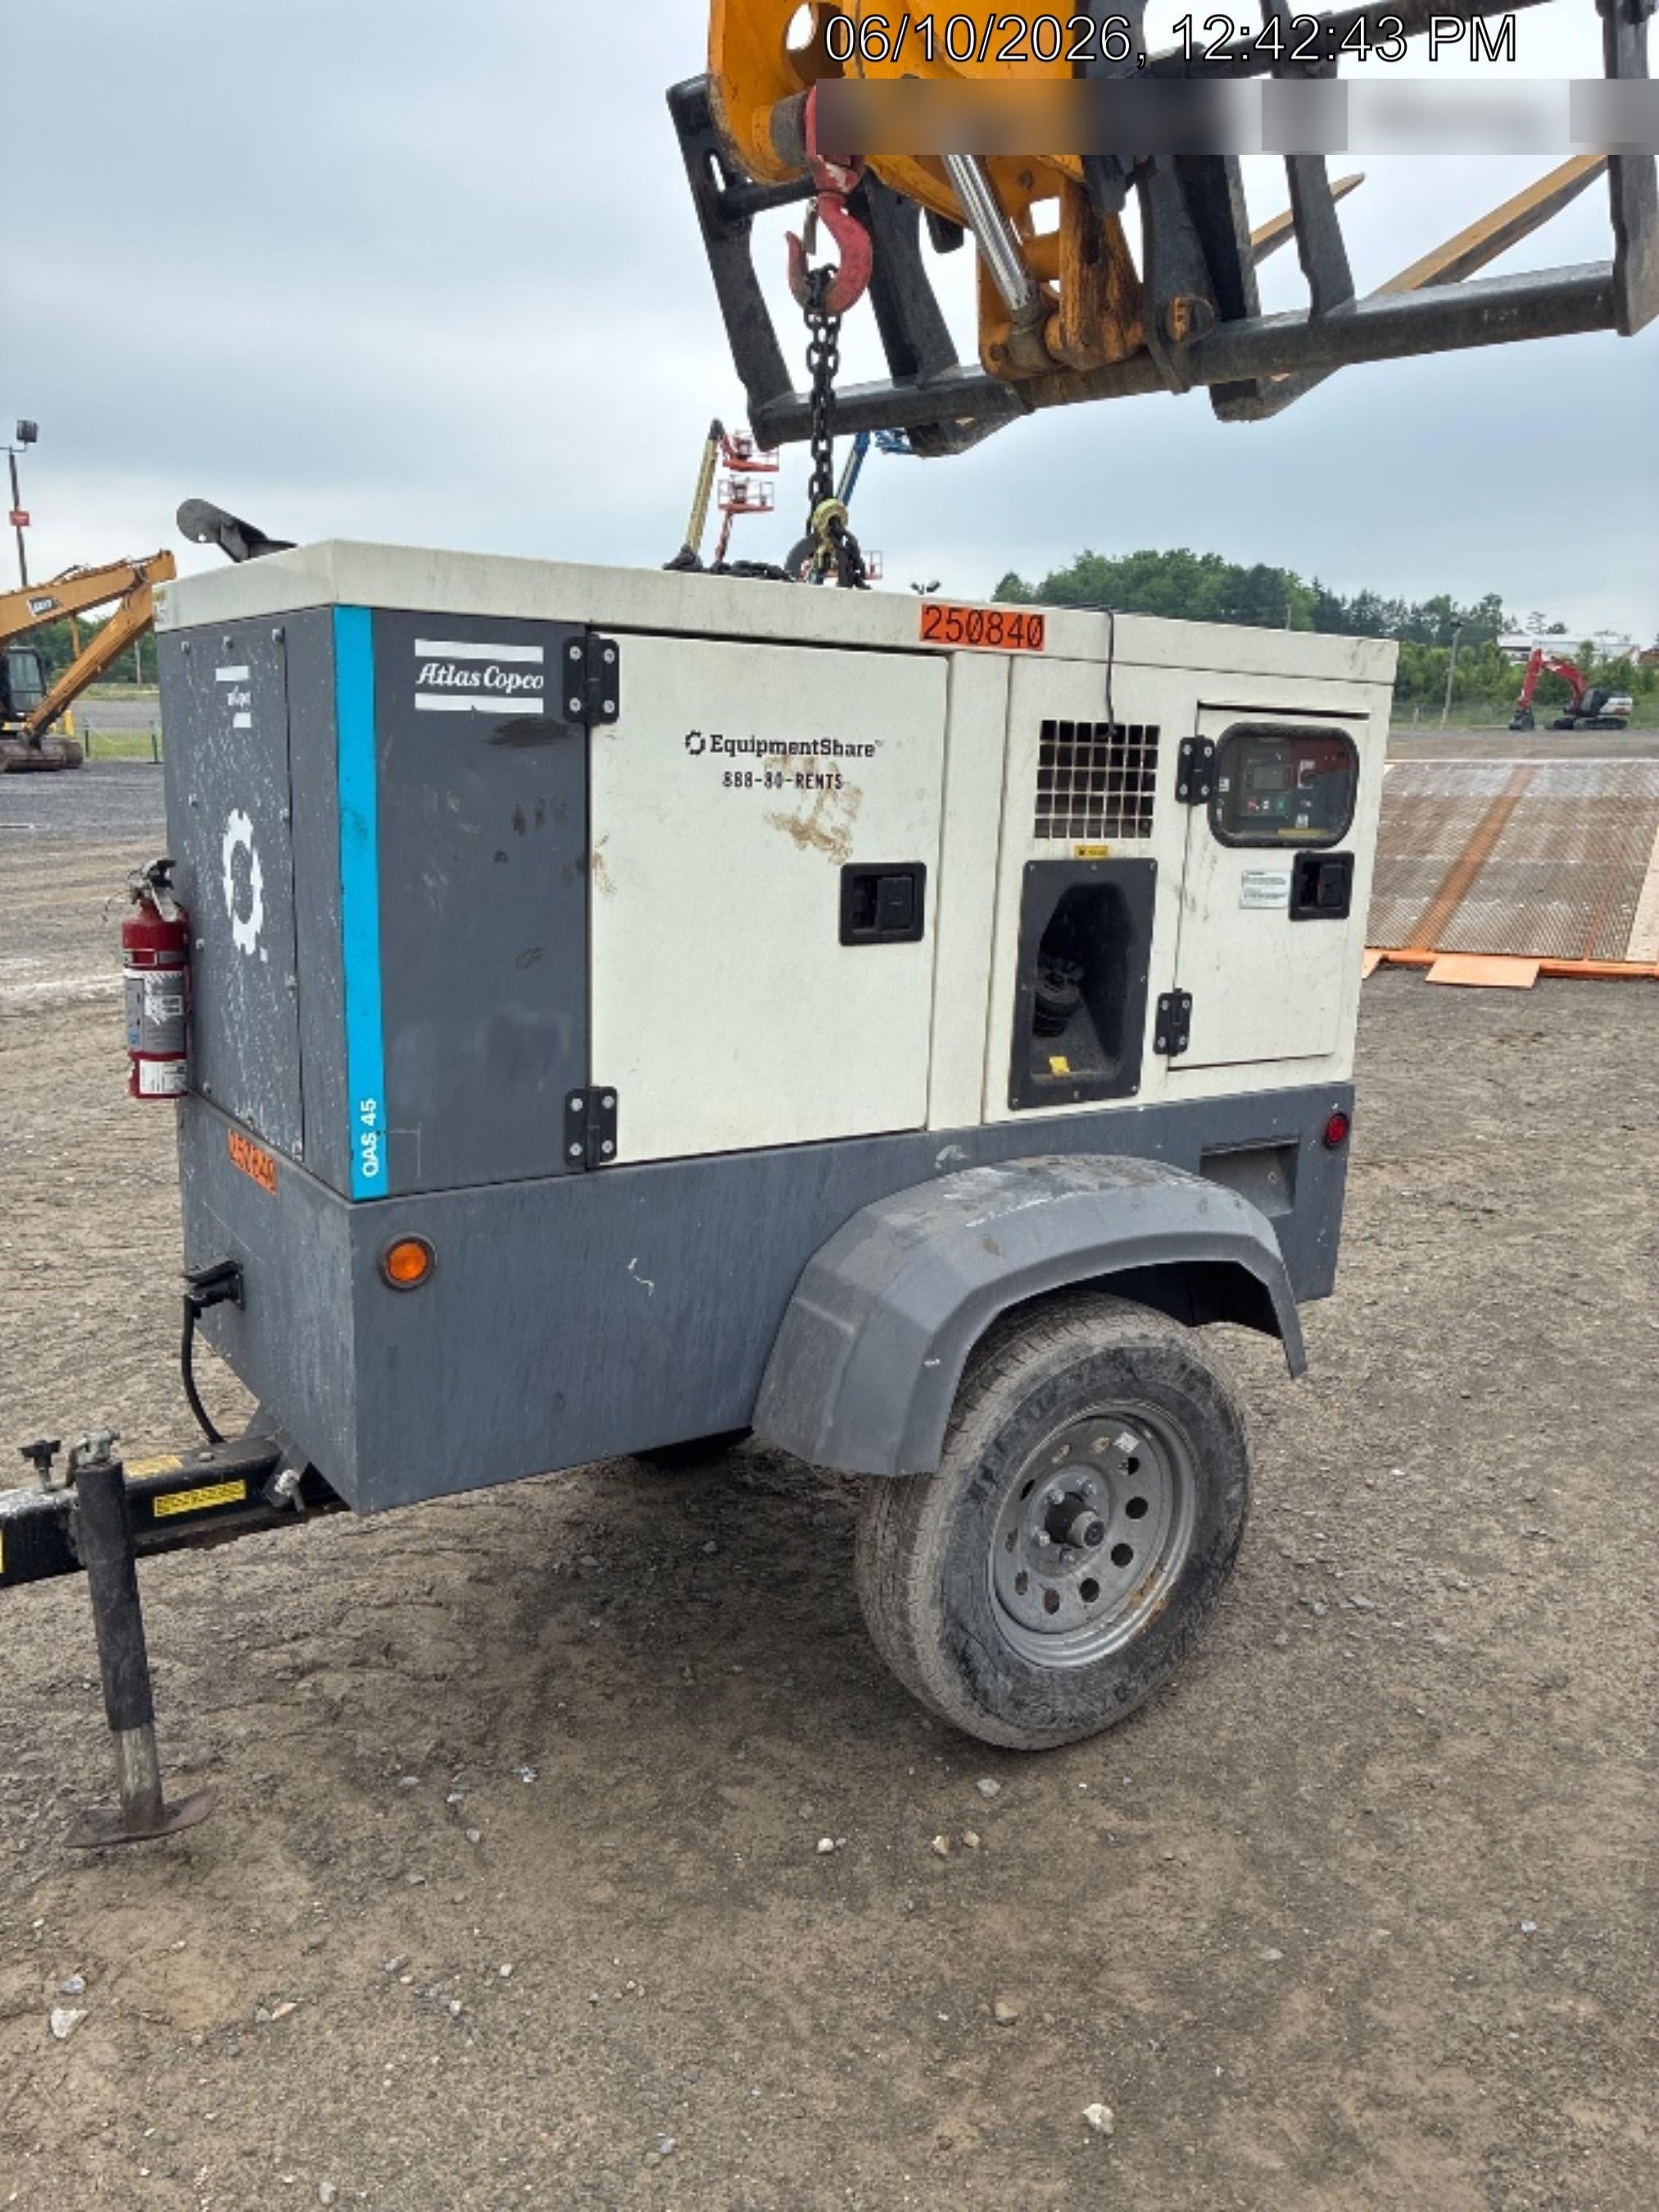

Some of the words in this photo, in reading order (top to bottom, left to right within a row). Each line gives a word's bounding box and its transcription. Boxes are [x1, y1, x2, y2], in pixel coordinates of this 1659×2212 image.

[922, 605, 1044, 648] 250840
[415, 663, 481, 687] Atlas
[483, 665, 544, 694] Copco
[709, 734, 876, 758] EquipmentShare
[723, 771, 843, 790] 888-80-RENTS
[360, 1098, 377, 1126] 45
